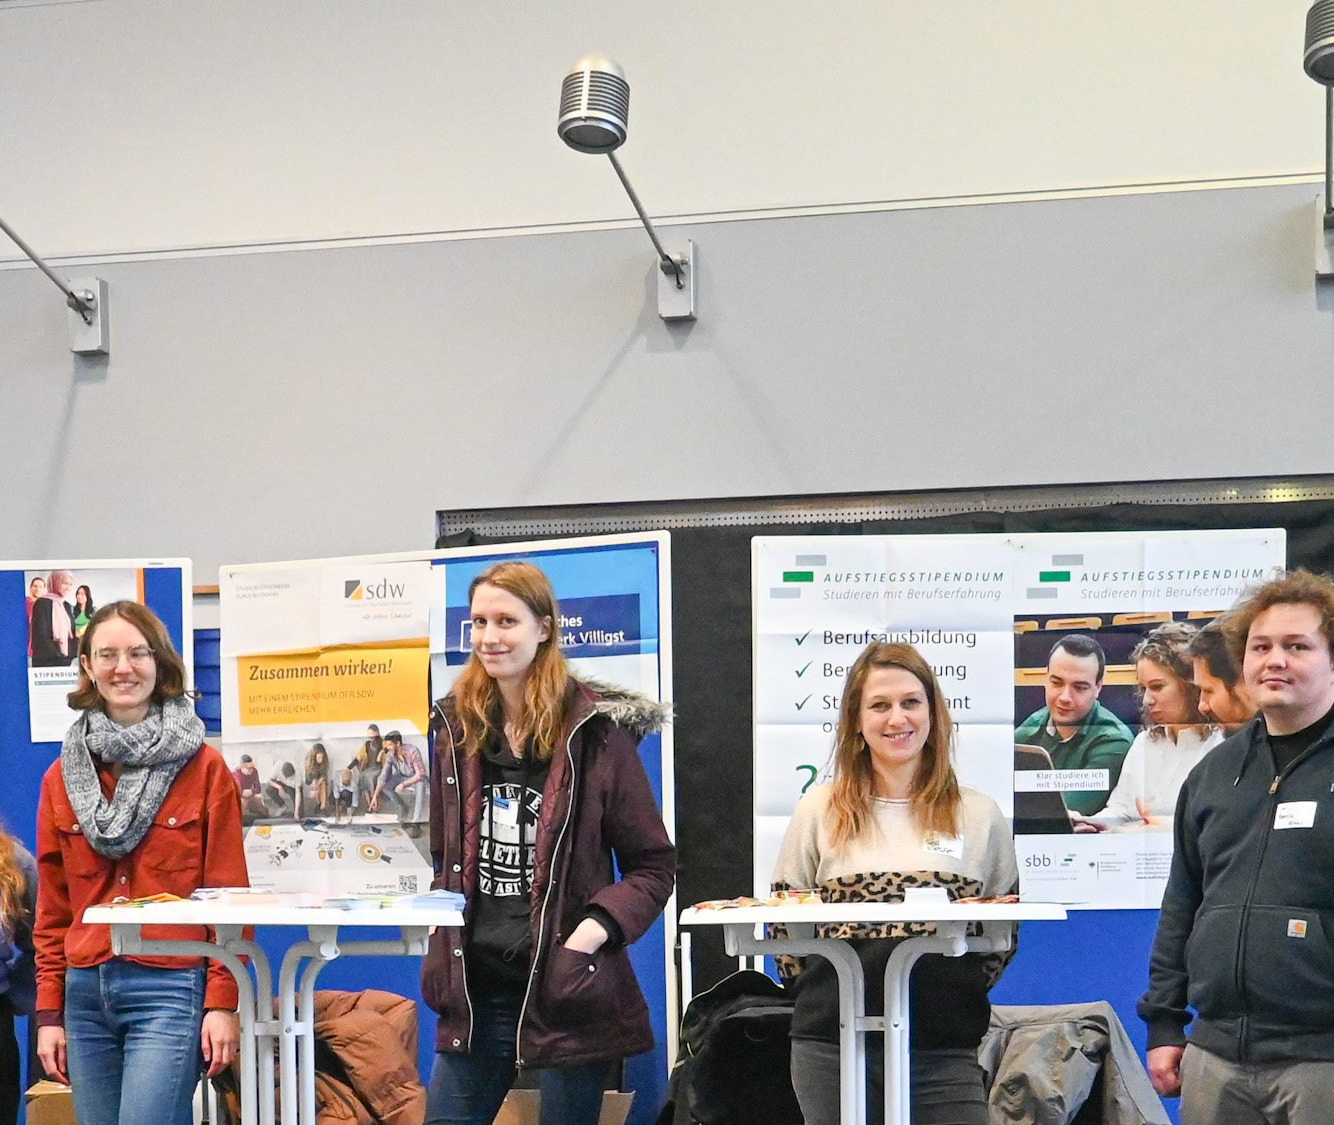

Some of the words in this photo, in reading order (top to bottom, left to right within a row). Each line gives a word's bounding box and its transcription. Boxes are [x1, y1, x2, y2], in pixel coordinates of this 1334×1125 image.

[823, 572, 1004, 583] AUFSTIEGSSTIPENDIUM
[1081, 568, 1264, 582] AUFSTIEGSSTIPENDIUM
[366, 578, 405, 600] sdw
[824, 589, 879, 600] Studieren
[884, 588, 903, 599] mit
[907, 587, 1002, 601] Berufserfahrung
[1081, 588, 1138, 600] Studieren
[1142, 587, 1161, 598] mit
[580, 629, 625, 647] Villigst
[823, 629, 977, 647] Berufsausbildung
[249, 664, 330, 682] Zusammen
[333, 658, 394, 677] wirken!
[249, 695, 264, 703] MIT
[264, 693, 289, 702] EINEM
[291, 691, 338, 701] STIPENDIUM
[339, 690, 356, 700] DER
[356, 689, 375, 699] SDW
[249, 706, 272, 715] MEHR
[273, 704, 317, 714] ERREICHEN
[1055, 771, 1089, 779] studiere
[1091, 770, 1104, 778] ich
[1053, 780, 1105, 789] Stipendium!
[1025, 853, 1051, 868] sbb
